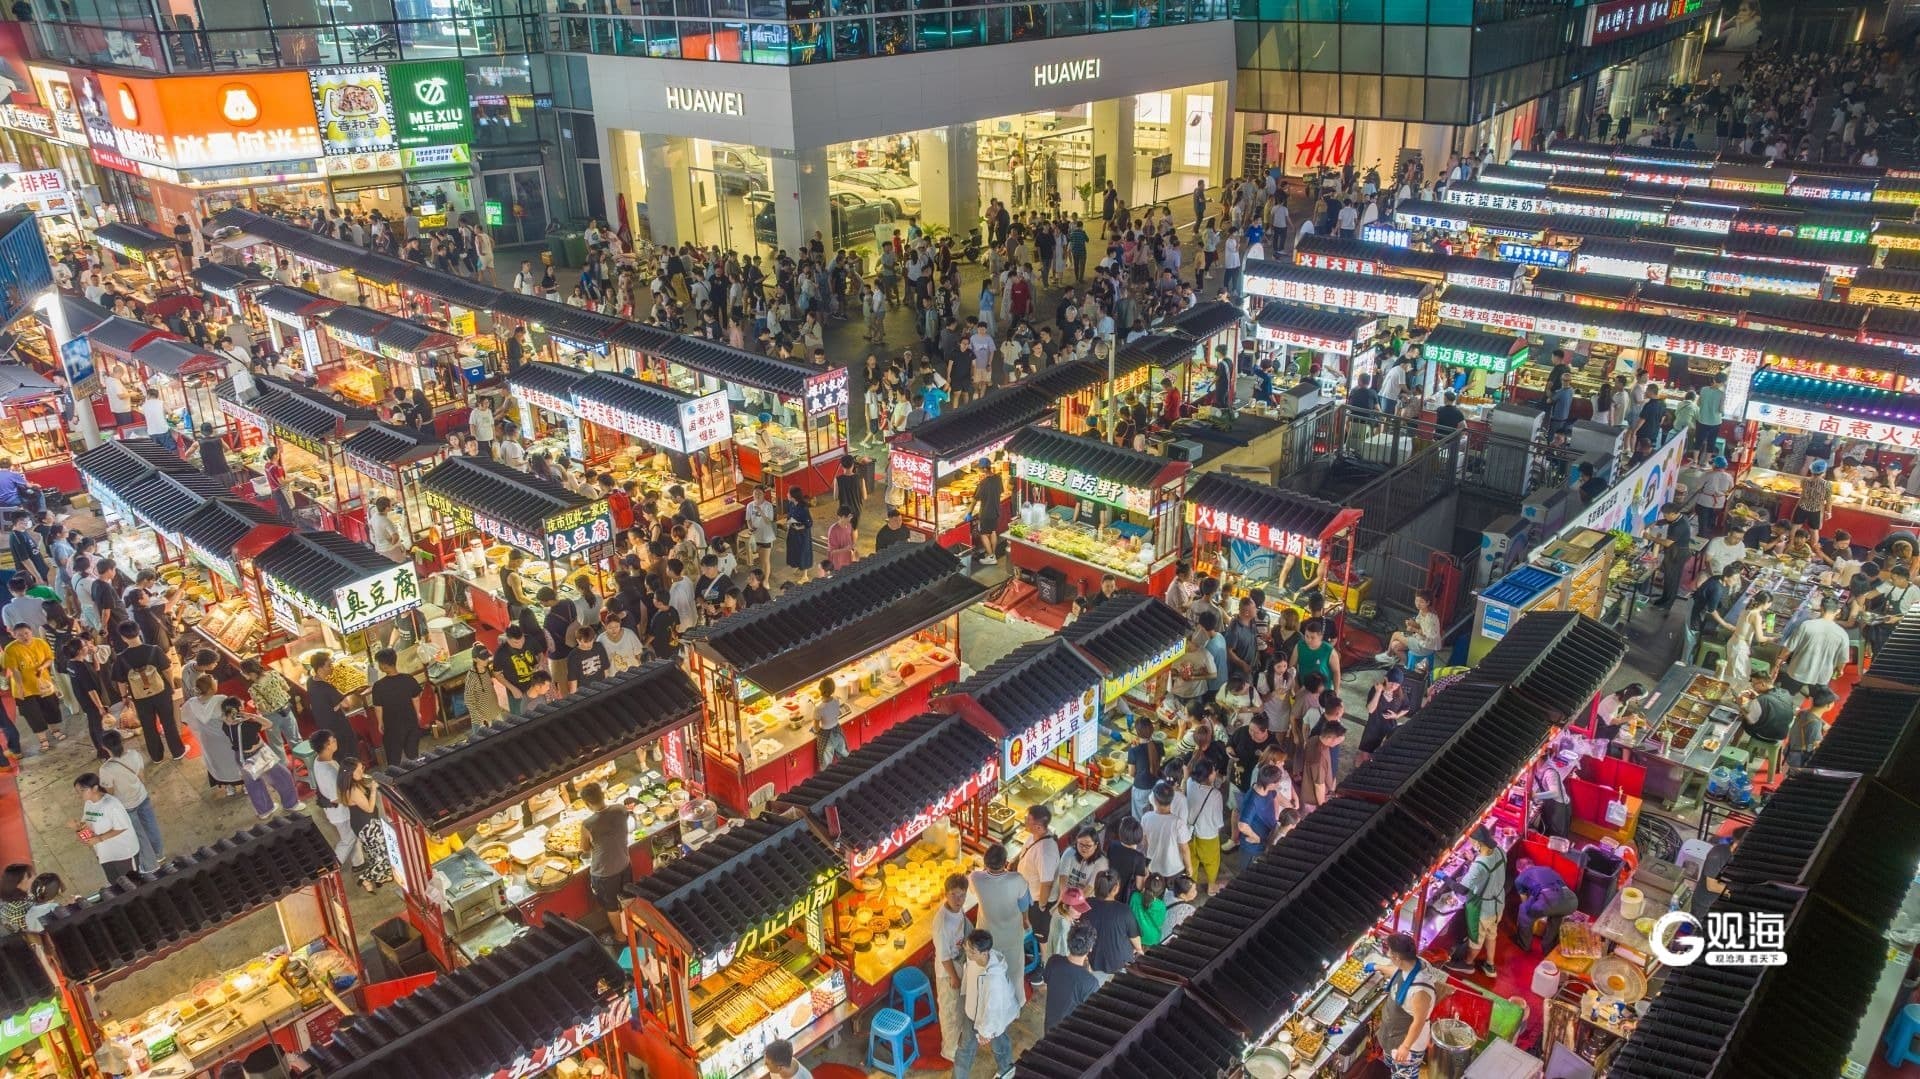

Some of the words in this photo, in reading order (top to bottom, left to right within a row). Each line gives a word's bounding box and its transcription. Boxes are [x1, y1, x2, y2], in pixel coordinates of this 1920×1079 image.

[1034, 58, 1101, 88] HUAWEI
[666, 87, 744, 116] HUAWEI
[337, 118, 379, 131] 香和香
[409, 111, 434, 124] ME
[437, 108, 463, 121] XIU
[1295, 123, 1356, 168] H&M
[12, 171, 61, 193] 排档
[1450, 191, 1533, 212] 鲜花罐罐烤奶
[1265, 280, 1398, 313] 沈阳特色拌鸡架
[1450, 306, 1504, 325] 生烤鸡架
[1664, 337, 1759, 365] 手打鲜虾滑
[697, 398, 720, 412] 老北京
[689, 410, 725, 432] 卤煮火烧
[892, 454, 931, 477] 钵钵鸡
[551, 519, 611, 557] 臭豆腐
[1268, 528, 1302, 556] 鸭肠
[344, 568, 417, 622] 臭豆腐
[1026, 715, 1080, 765] 狼牙土豆
